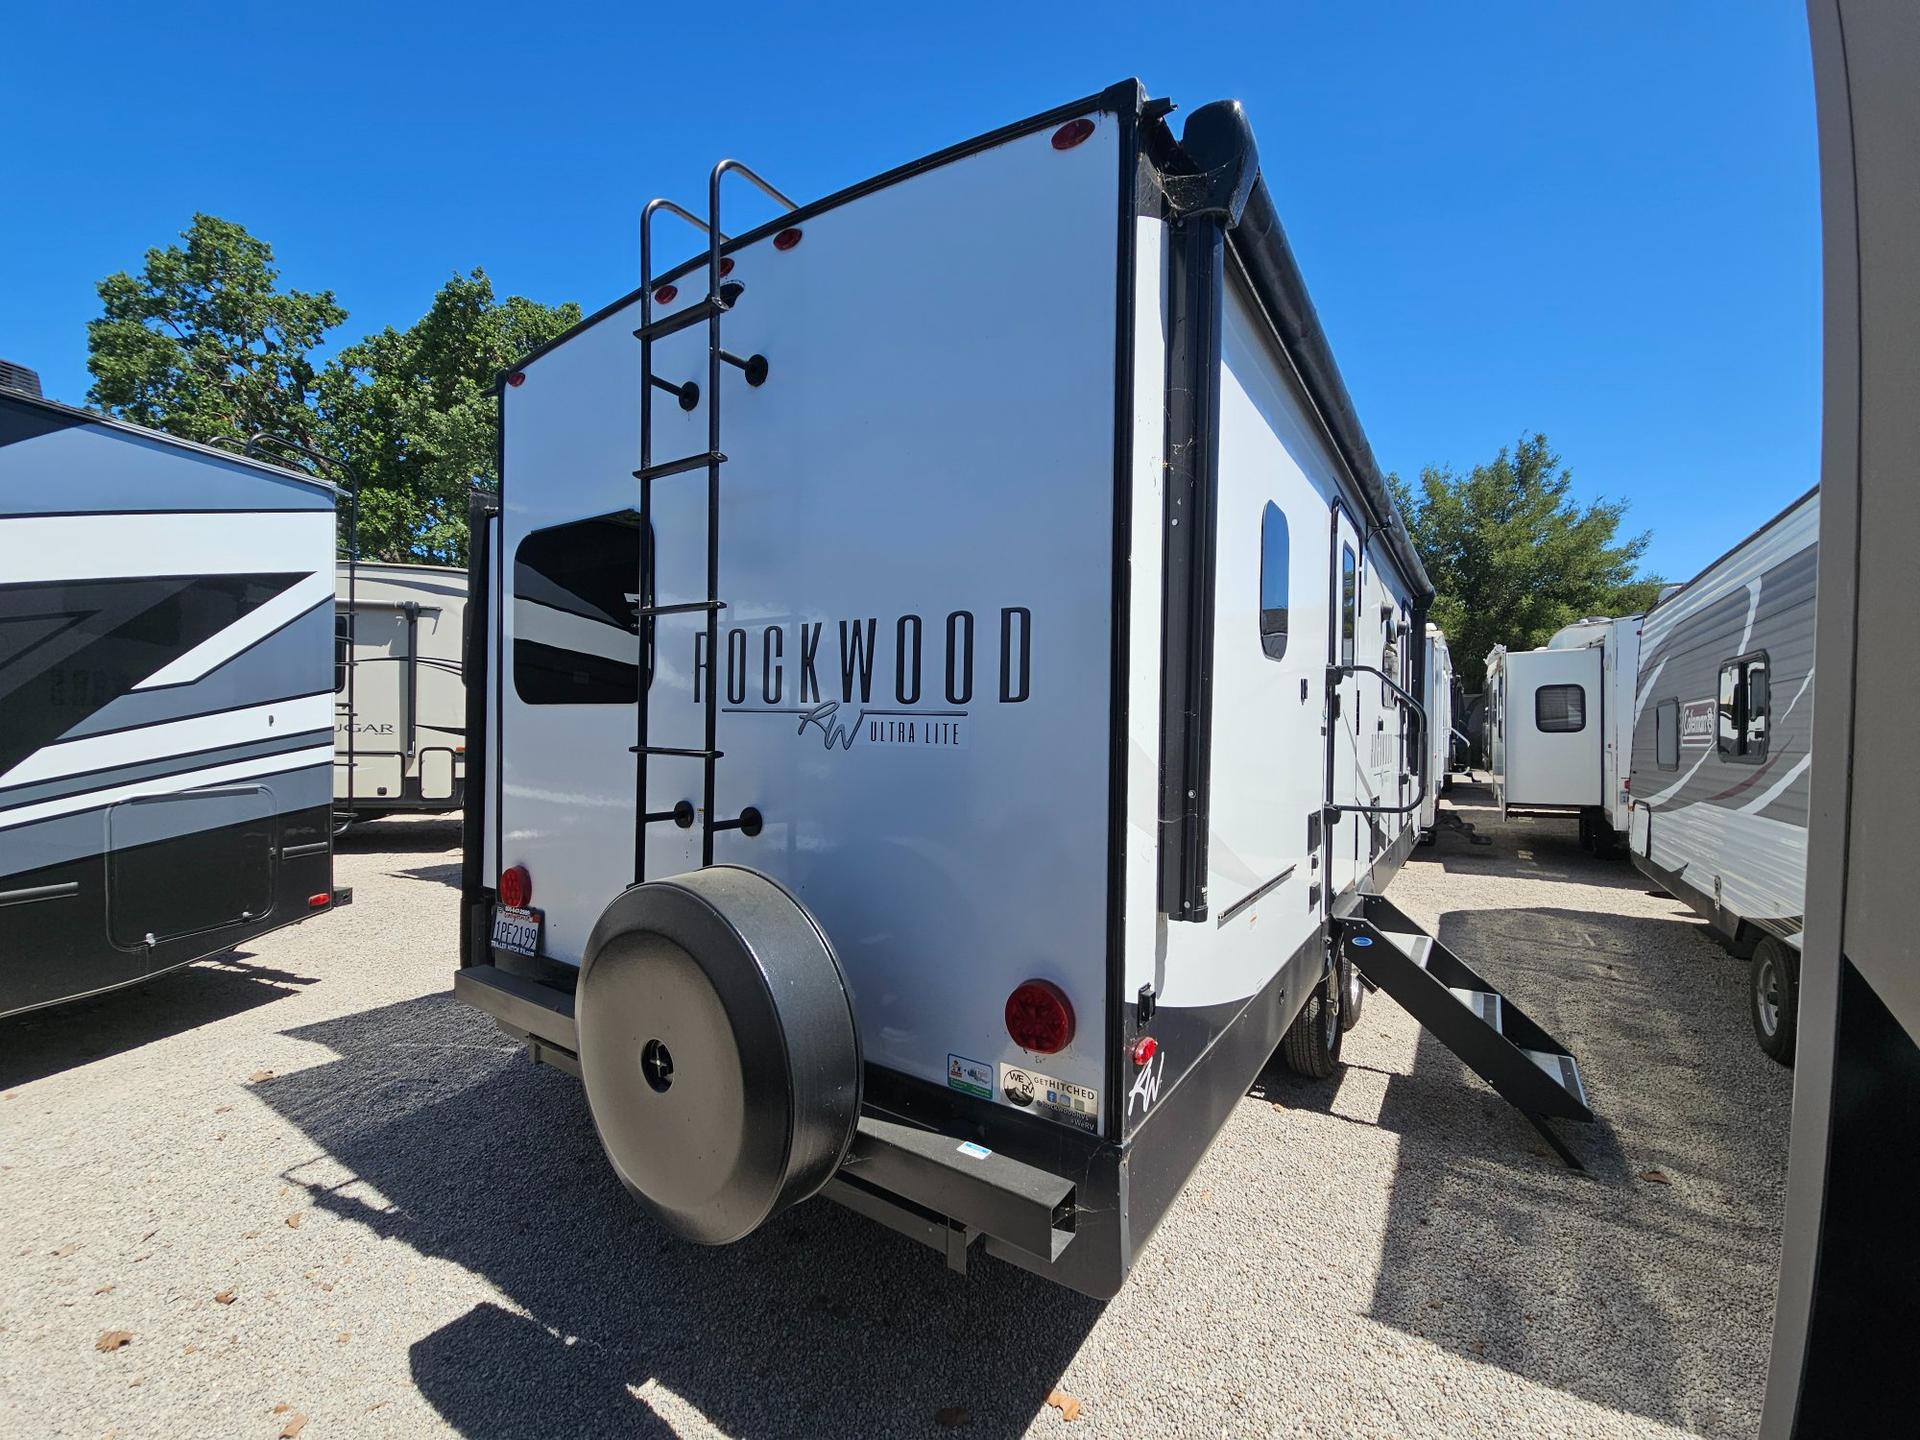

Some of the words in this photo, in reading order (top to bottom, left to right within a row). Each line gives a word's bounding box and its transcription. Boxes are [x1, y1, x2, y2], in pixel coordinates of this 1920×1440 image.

[694, 606, 1031, 705] ROCKWOOD
[870, 720, 916, 744] ULTRA
[925, 722, 960, 745] LITE
[1009, 1071, 1024, 1084] WE
[1022, 1082, 1035, 1095] RV
